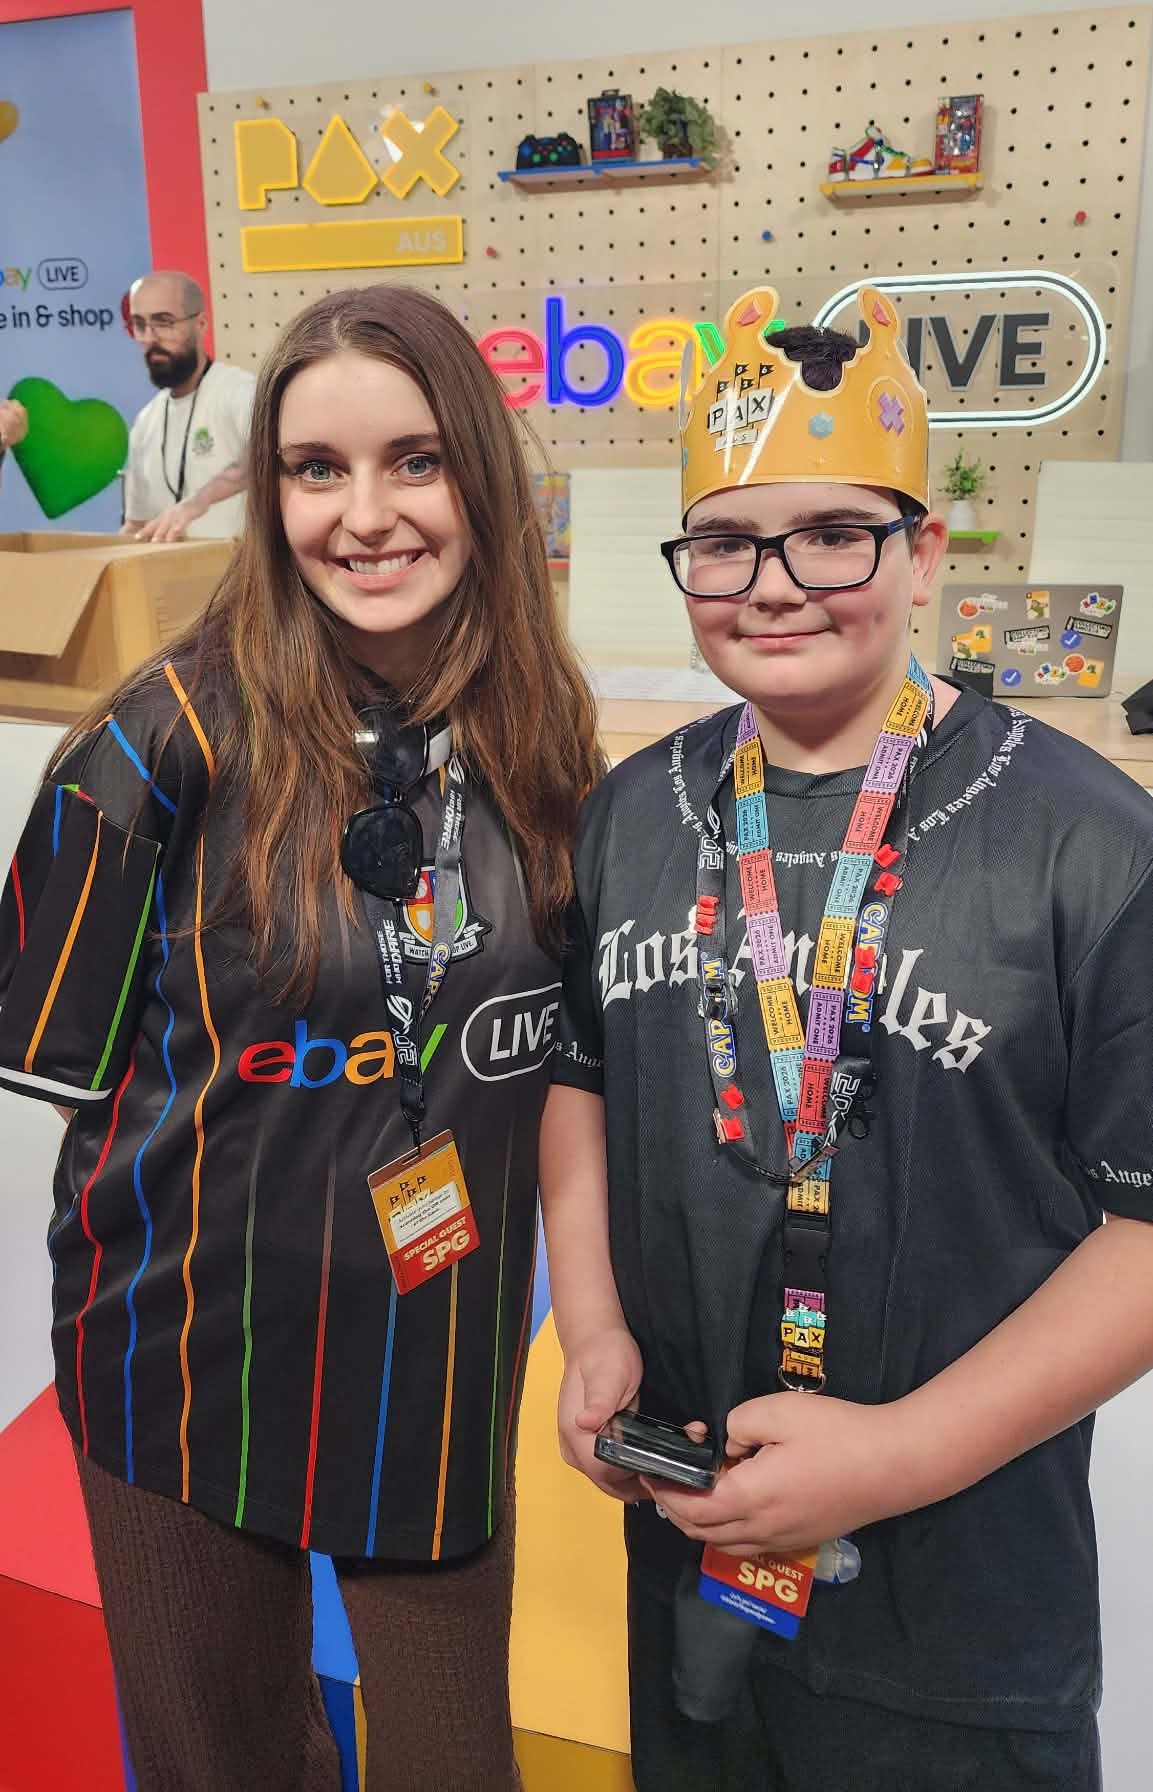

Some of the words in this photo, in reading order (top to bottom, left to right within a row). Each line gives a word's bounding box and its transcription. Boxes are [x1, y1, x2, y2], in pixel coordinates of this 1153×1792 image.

[234, 106, 461, 209] PAX
[396, 229, 447, 253] AUS
[46, 266, 79, 282] LIVE
[12, 305, 31, 328] in
[36, 305, 53, 328] &
[58, 304, 114, 331] shop
[858, 311, 1050, 388] IVE
[712, 395, 767, 426] PAX
[945, 772, 997, 813] Angeles
[919, 809, 950, 831] Los
[408, 946, 429, 958] WATCH
[599, 905, 698, 1012] Los
[822, 940, 830, 964] HOME
[835, 933, 846, 973] WELCOME
[701, 957, 737, 1077] CAPM
[767, 995, 779, 1035] WELCOME
[782, 1001, 792, 1025] HOME
[815, 1002, 823, 1026] ADMIT
[489, 1002, 559, 1061] LIVE
[827, 1024, 835, 1045] 2026
[804, 1082, 814, 1109] HOME
[404, 1235, 439, 1260] SPECIAL
[439, 1216, 466, 1238] GUEST
[423, 1230, 470, 1271] SPG
[784, 1327, 821, 1343] PAX
[737, 1561, 799, 1603] SPG
